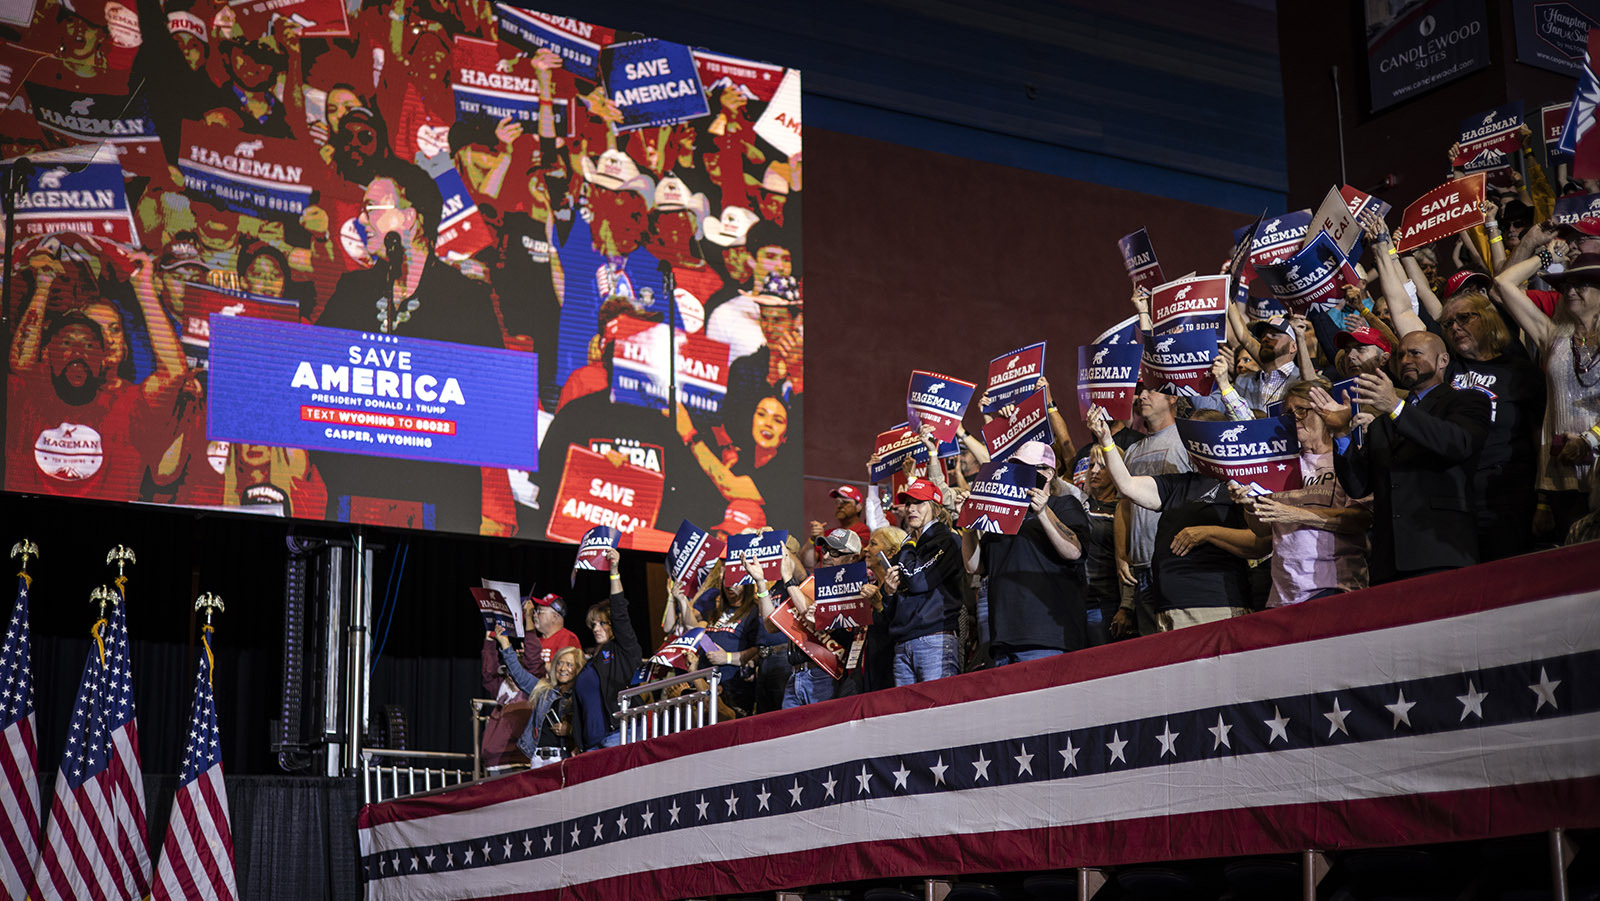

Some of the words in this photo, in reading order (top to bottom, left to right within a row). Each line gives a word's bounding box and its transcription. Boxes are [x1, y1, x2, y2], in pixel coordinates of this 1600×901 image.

[1543, 8, 1592, 33] Hampton
[1380, 20, 1480, 73] CANDLEWOOD
[625, 57, 671, 80] SAVE
[1415, 50, 1447, 70] SUTES
[1392, 58, 1474, 97] www.candewood.com
[614, 78, 697, 107] AMERICA!
[39, 107, 146, 135] HAGEMAN
[1461, 115, 1518, 142] HAGEMAN
[191, 145, 302, 184] HAGEMAN
[1463, 155, 1502, 170] GEMAN
[1421, 192, 1460, 216] SAVE
[27, 222, 44, 234] FOR
[45, 221, 95, 235] WYOMING
[1404, 201, 1478, 239] AMERICA!
[1251, 224, 1309, 250] AGEMAN
[1259, 251, 1272, 261] FOR
[1271, 244, 1300, 257] WYOMING
[1271, 255, 1338, 294] HAGEMAN
[1303, 282, 1335, 303] WYOMING
[1156, 297, 1219, 320] HAGEMAN
[1185, 323, 1194, 331] TO
[348, 345, 412, 371] SAVE
[290, 360, 466, 406] AMERICA
[990, 363, 1036, 386] HAGEMAN
[1079, 366, 1132, 380] HAGEMAN
[1164, 371, 1198, 380] WYOMING
[1455, 370, 1497, 389] TRUMP
[311, 393, 363, 407] PRESIDENT
[364, 398, 404, 411] DONALD
[405, 403, 414, 412] J.
[416, 403, 446, 414] TRUMP
[911, 391, 962, 412] HAGEMAN
[307, 408, 335, 420] TEXT
[338, 411, 396, 427] WYOMING
[398, 417, 414, 429] TO
[992, 408, 1040, 450] HAGEMAN
[43, 436, 99, 449] HAGEMAN
[324, 427, 375, 444] CASPER,
[376, 432, 433, 449] WYOMING
[1187, 439, 1288, 458] HAGEMAN
[874, 462, 887, 473] TEXT
[1210, 465, 1225, 475] FOR
[1226, 465, 1269, 477] WYOMING
[589, 478, 636, 507] SAVE
[972, 482, 1028, 500] HAGEMAN
[984, 504, 1011, 515] WYOMING
[671, 531, 701, 577] HAGEMAN
[817, 581, 863, 597] HAGEMAN
[828, 604, 837, 612] FOR
